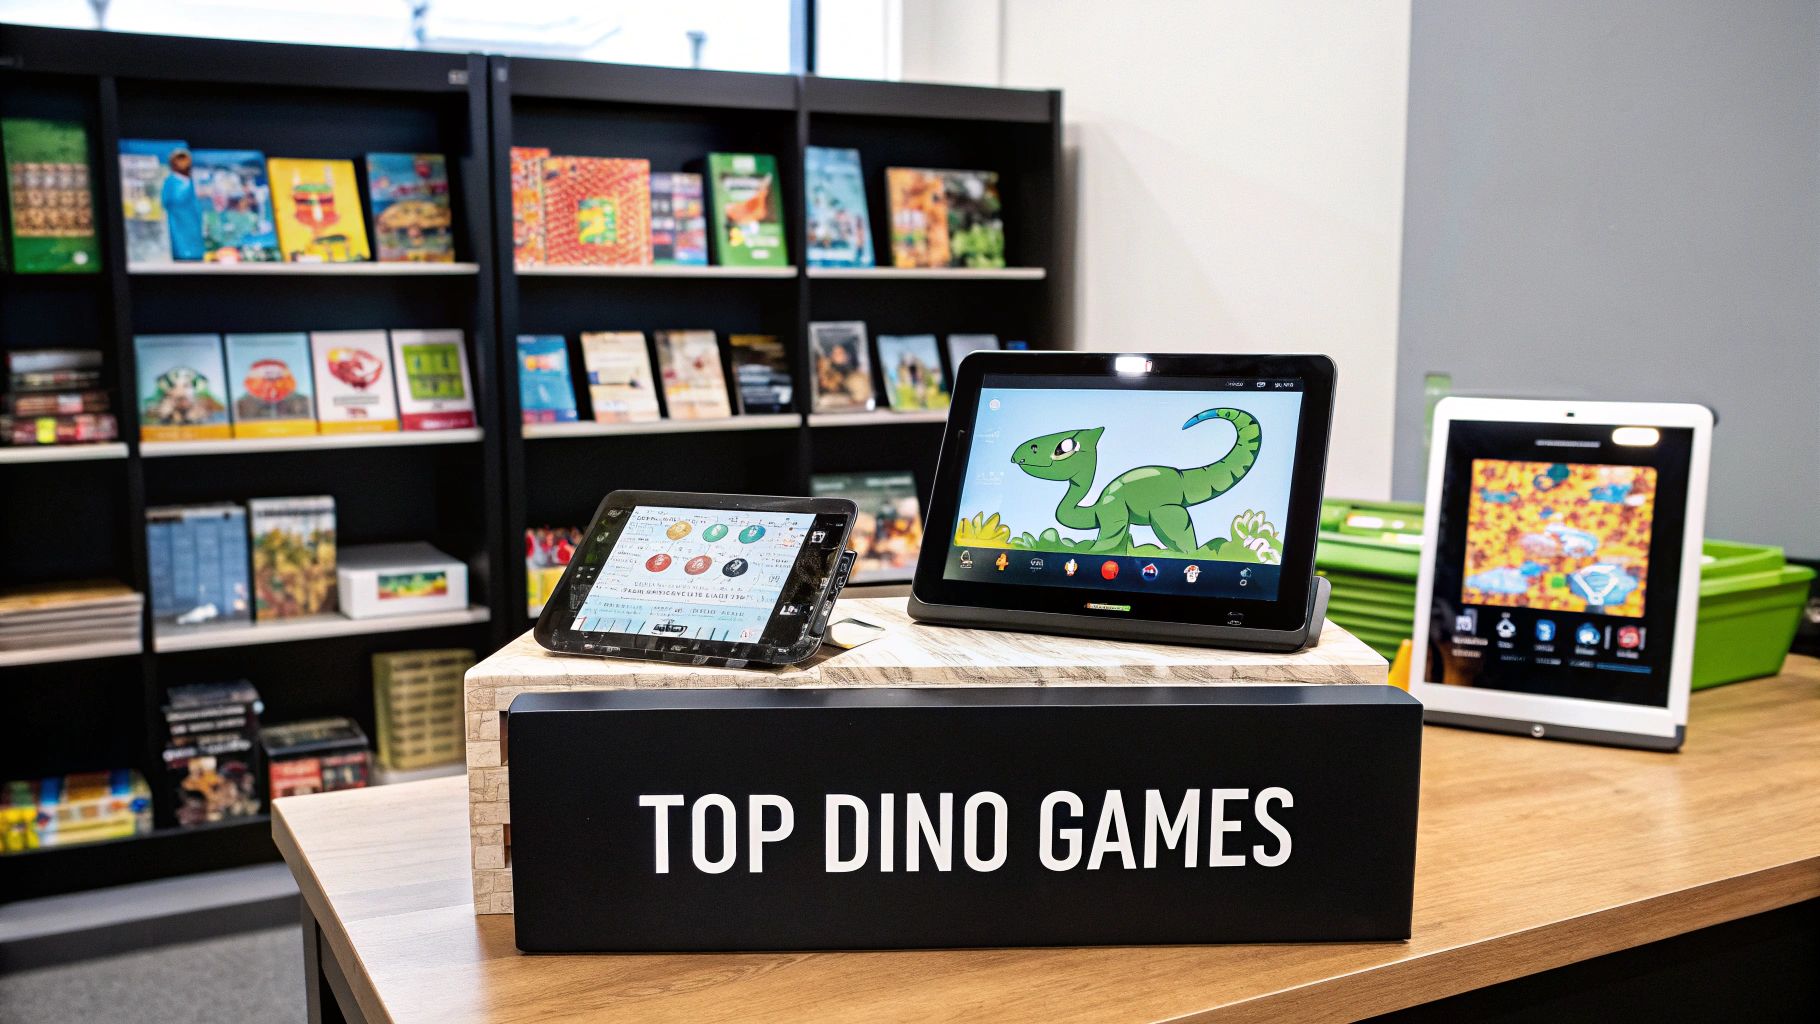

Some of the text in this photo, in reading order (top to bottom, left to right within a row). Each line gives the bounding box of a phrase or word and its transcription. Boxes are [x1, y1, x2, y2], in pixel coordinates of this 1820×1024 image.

[638, 787, 1294, 874] TOP DINO GAMES
